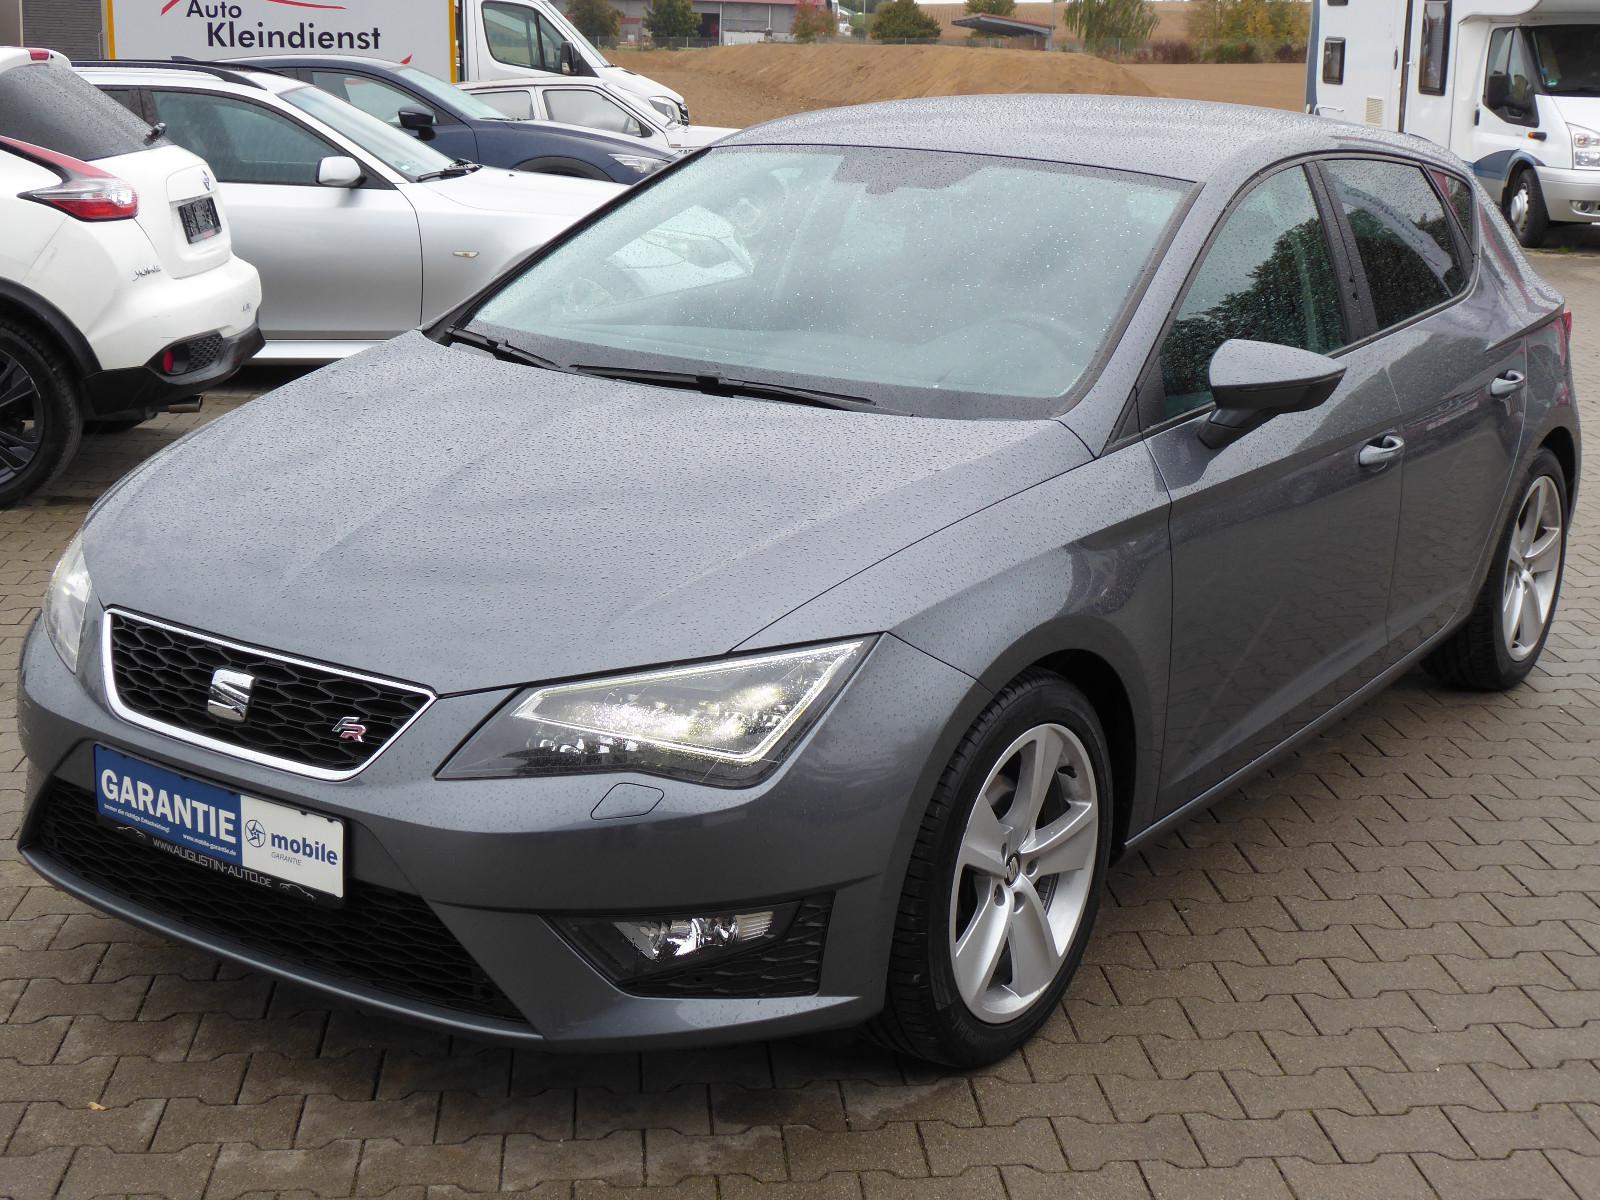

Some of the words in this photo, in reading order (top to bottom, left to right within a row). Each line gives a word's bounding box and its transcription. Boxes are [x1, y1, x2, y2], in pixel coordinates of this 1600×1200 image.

[186, 0, 242, 19] Auto
[207, 21, 381, 50] Kleindienst
[101, 768, 237, 844] GARANTIE
[271, 833, 338, 866] mobile
[271, 851, 303, 867] GARANTIE
